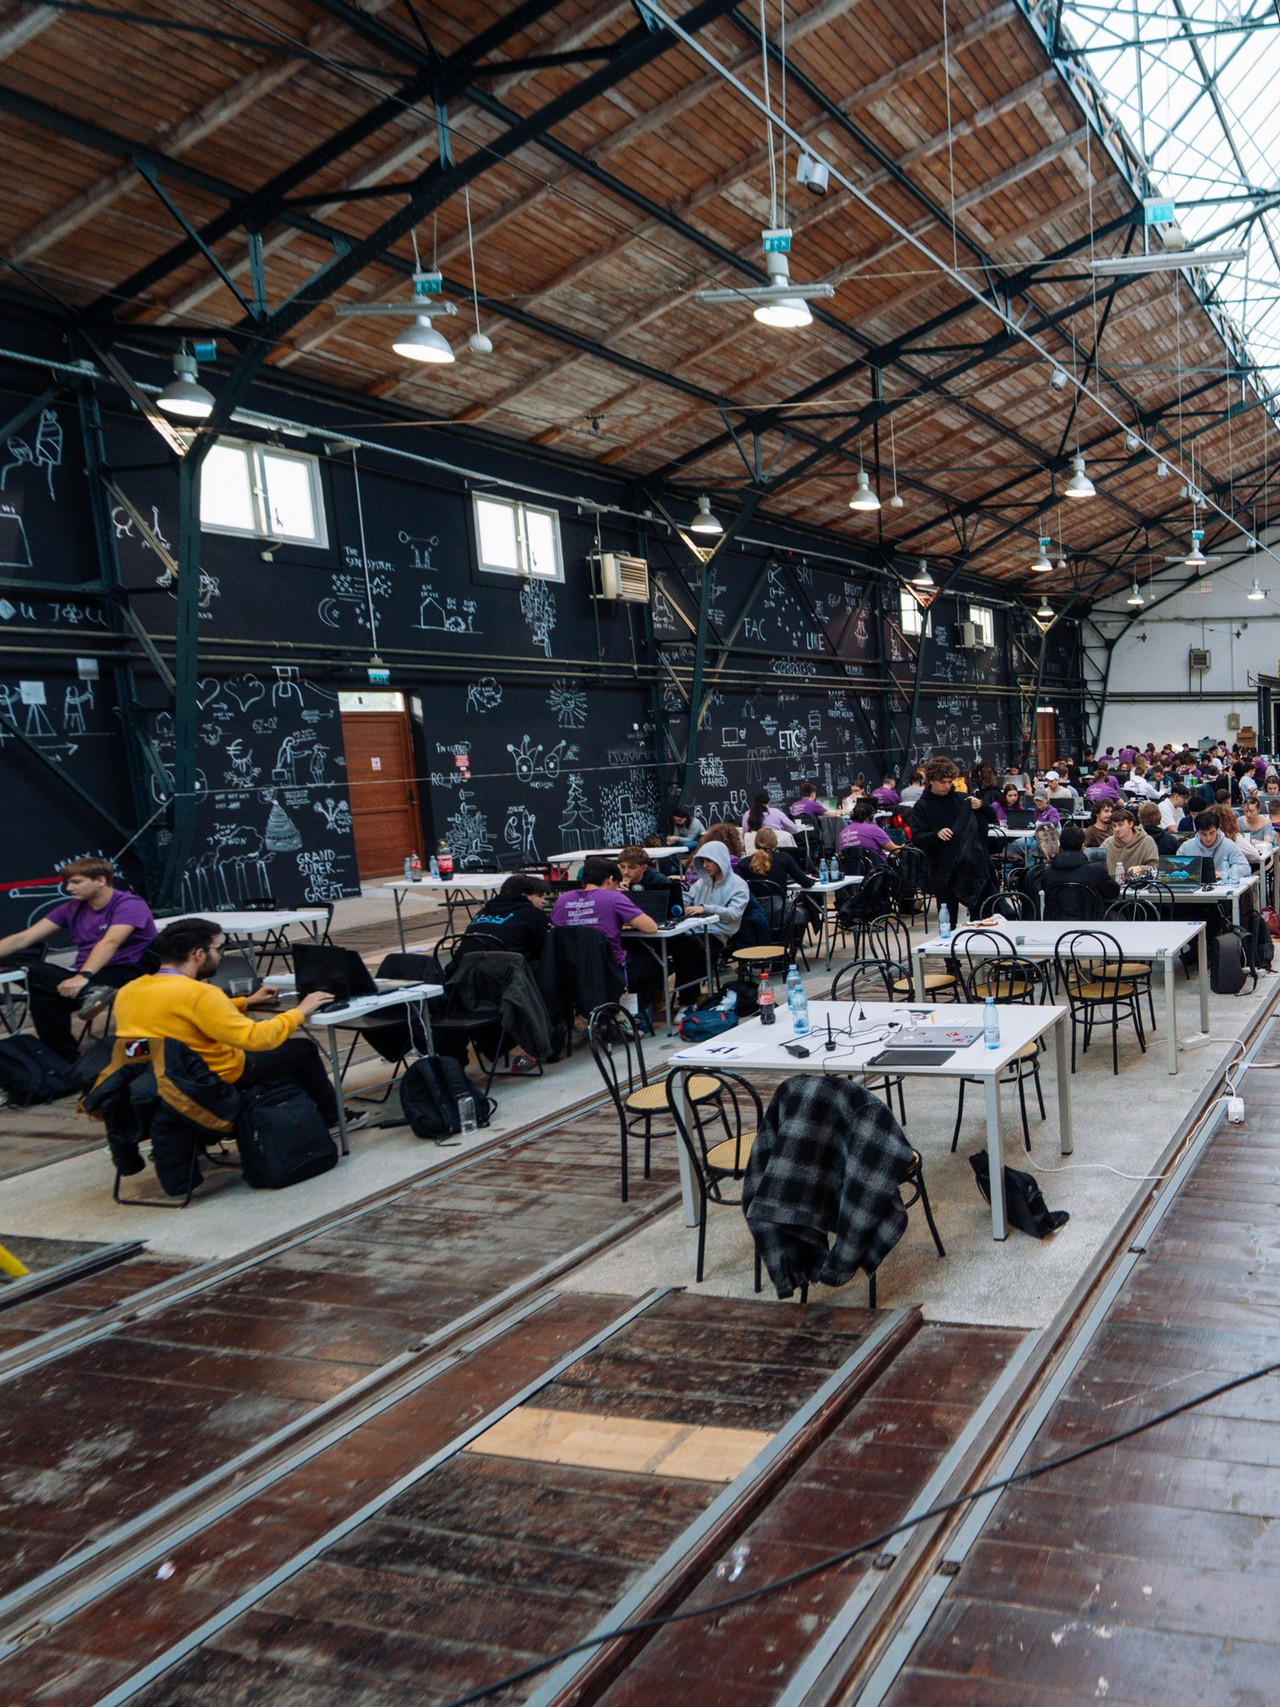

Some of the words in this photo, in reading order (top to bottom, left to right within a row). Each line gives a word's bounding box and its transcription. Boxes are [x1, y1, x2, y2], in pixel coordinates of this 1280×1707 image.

[743, 618, 767, 641] FAC
[806, 632, 825, 650] LIKE
[707, 757, 723, 768] SUIS
[700, 768, 724, 777] CHARLIE
[707, 777, 728, 787] AHMED
[296, 849, 336, 864] GRAND
[298, 862, 336, 876] SUPER
[310, 874, 329, 887] BIG
[304, 883, 343, 902] GREAT
[705, 1046, 738, 1054] 41
